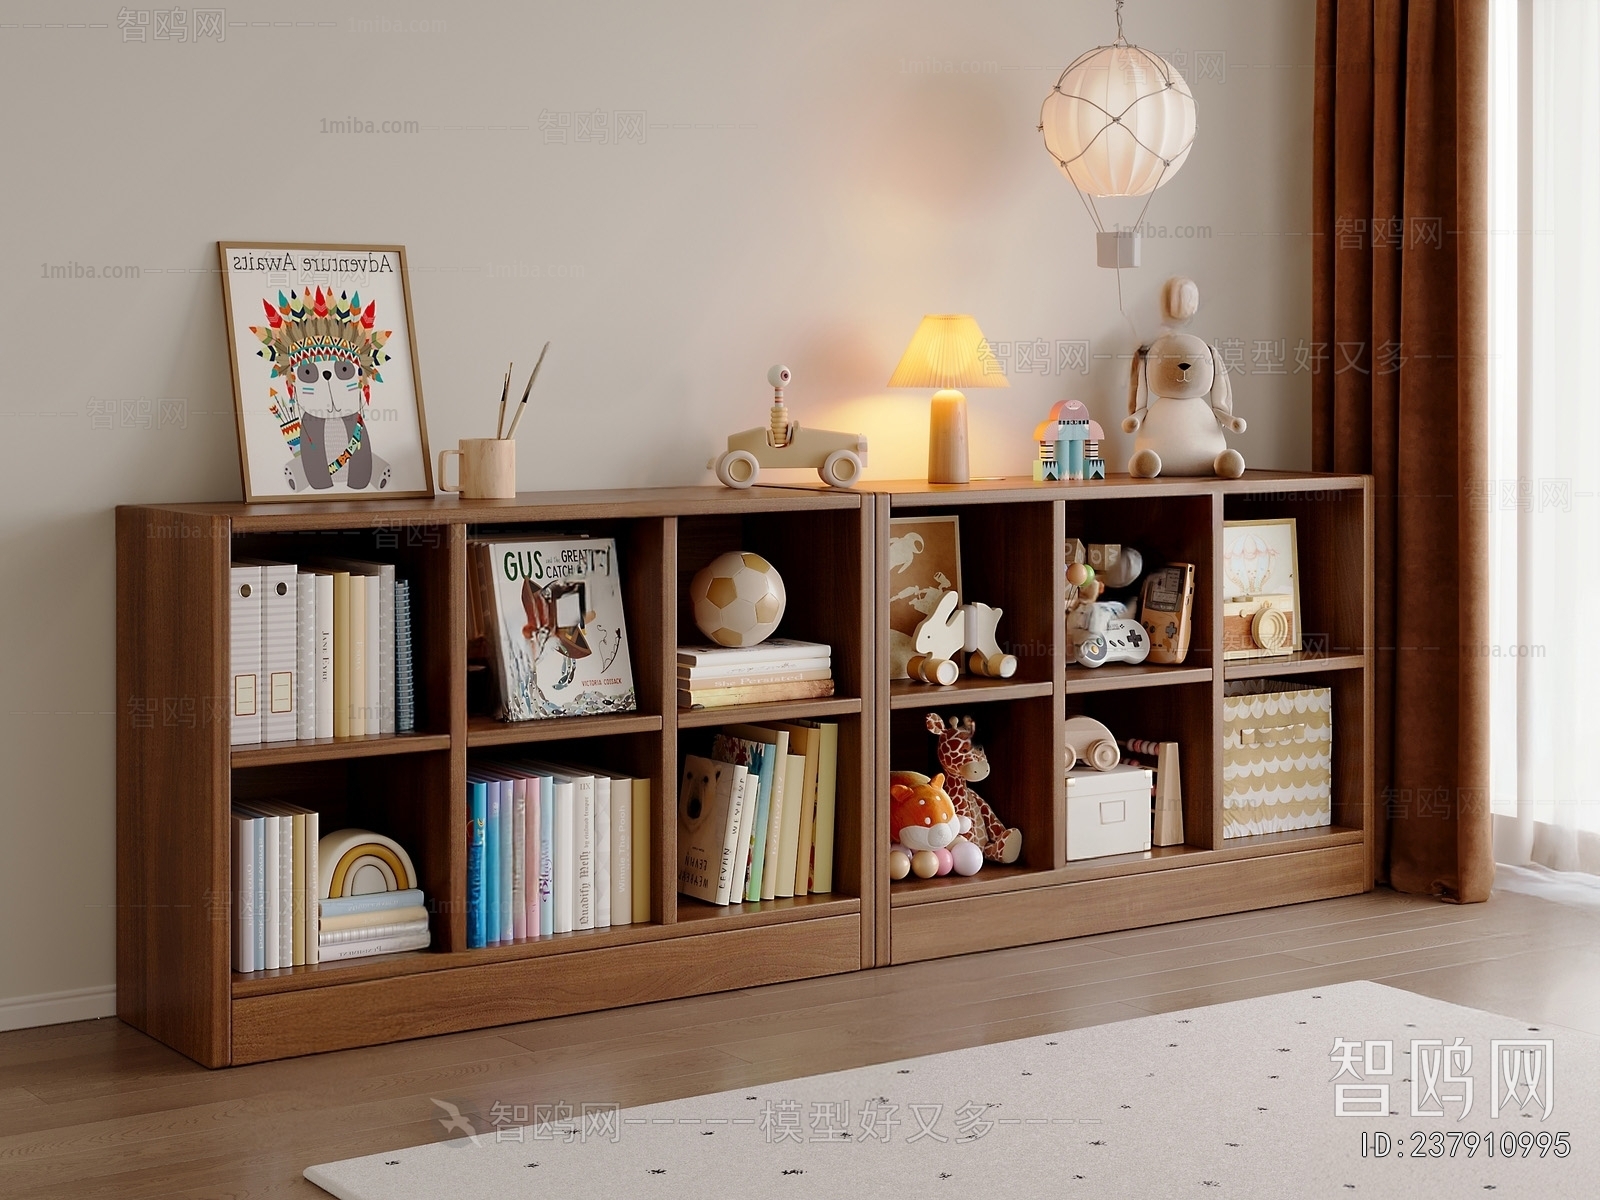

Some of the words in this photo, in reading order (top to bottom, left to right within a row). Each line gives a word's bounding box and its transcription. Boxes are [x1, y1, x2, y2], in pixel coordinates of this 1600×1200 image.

[503, 550, 544, 582] GUS
[321, 630, 331, 655] JANE
[321, 656, 331, 683] EYRE
[714, 680, 736, 688] She
[740, 673, 804, 685] Persisted
[618, 805, 626, 832] Pooh
[618, 835, 626, 855] The
[618, 857, 626, 893] Winnie
